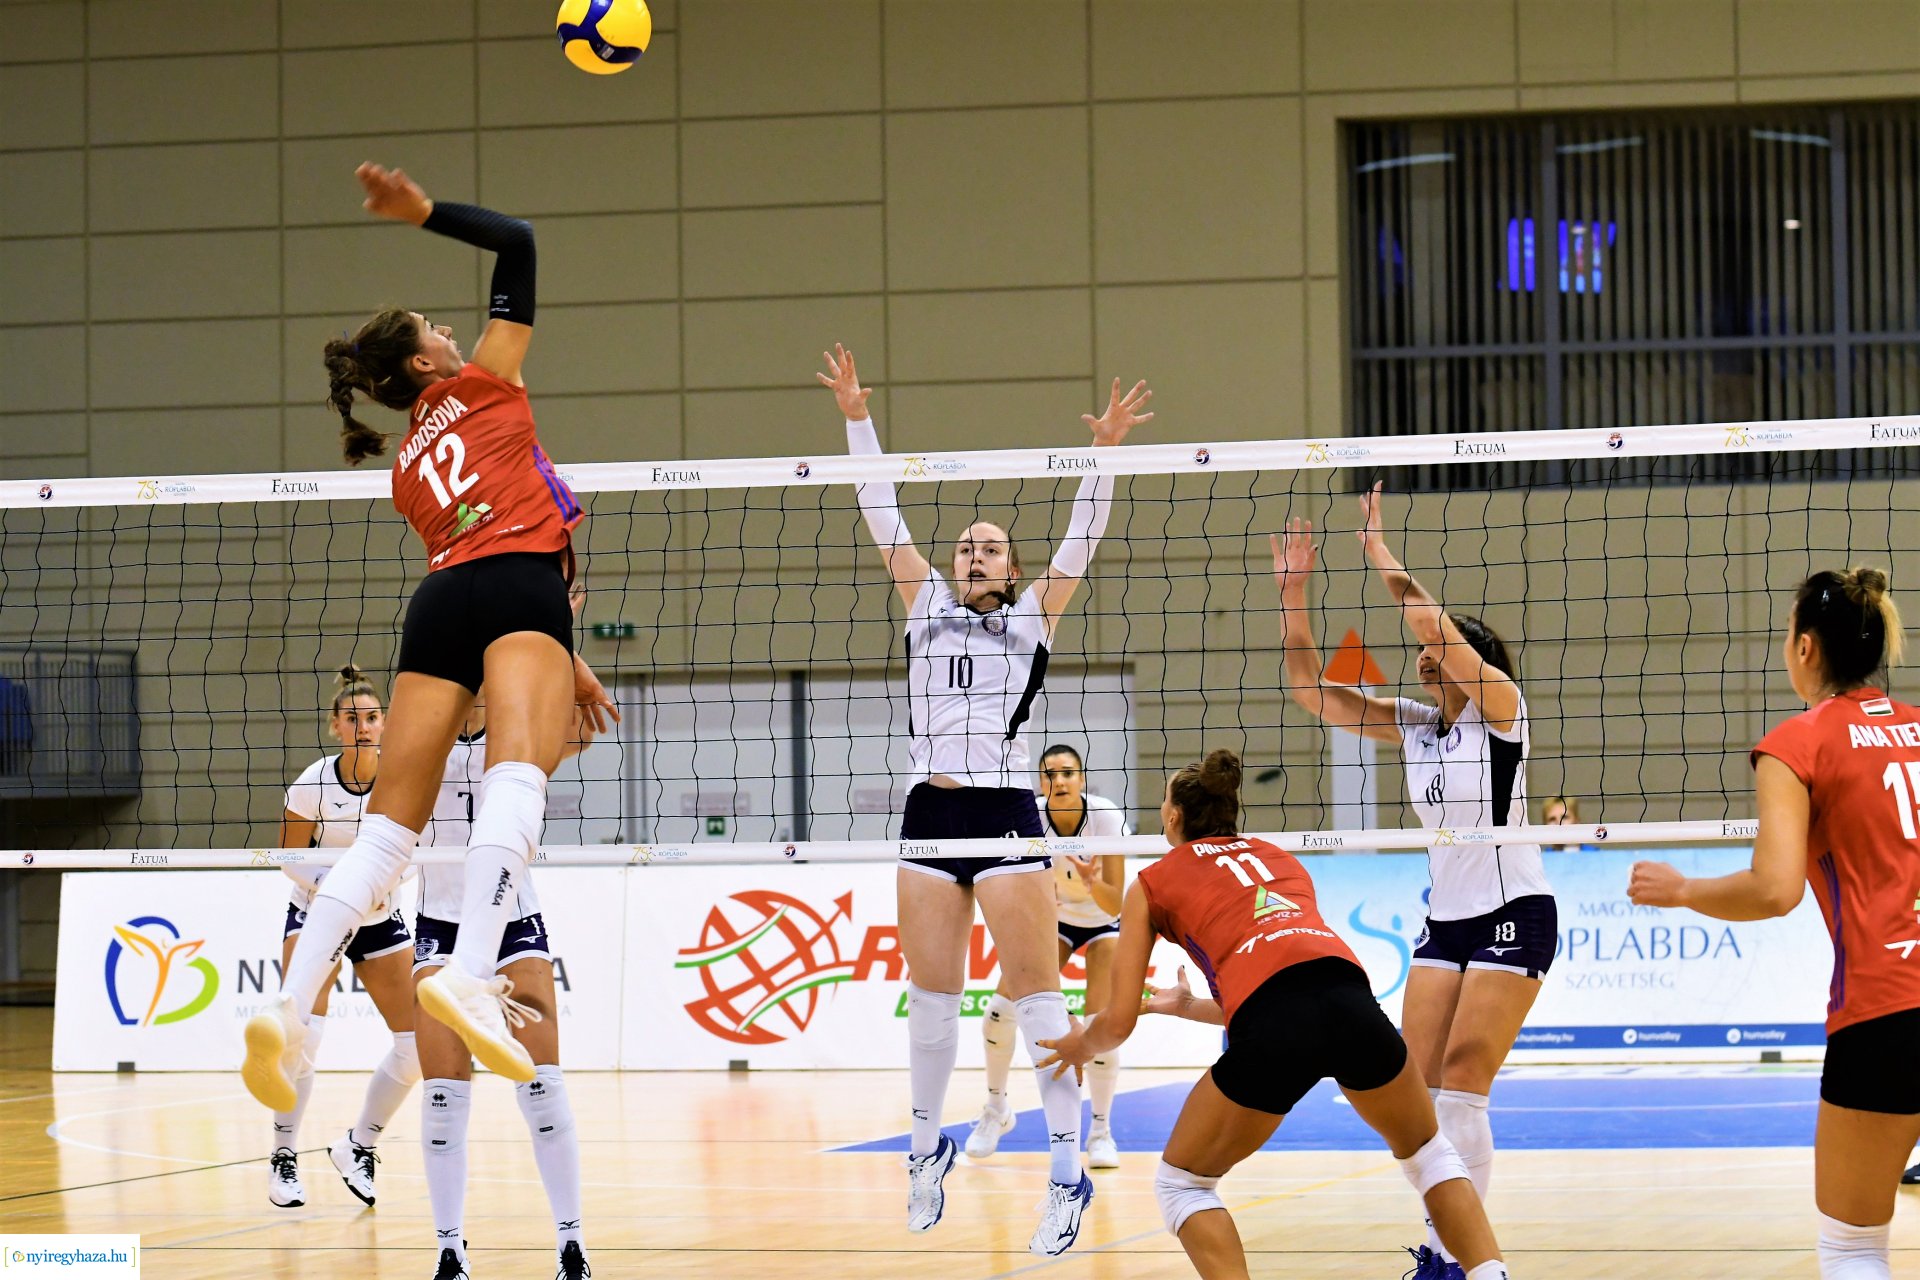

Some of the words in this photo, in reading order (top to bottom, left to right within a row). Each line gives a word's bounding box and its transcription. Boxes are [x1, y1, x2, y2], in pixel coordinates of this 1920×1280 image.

[399, 395, 468, 474] RADOSOVA
[1869, 423, 1920, 439] FATUM
[1455, 440, 1506, 454] FATUM
[418, 432, 480, 509] 12
[1046, 455, 1098, 469] FATUM
[651, 467, 701, 482] FATUM
[272, 479, 319, 493] FATUM
[949, 655, 973, 689] 10
[1848, 723, 1893, 749] ANA
[1425, 773, 1443, 806] 18
[457, 792, 474, 823] 7
[899, 843, 939, 855] FATUM
[1302, 834, 1343, 847] FATUM
[131, 852, 168, 864] FATUM
[1215, 853, 1275, 887] 11
[1495, 921, 1516, 942] 18
